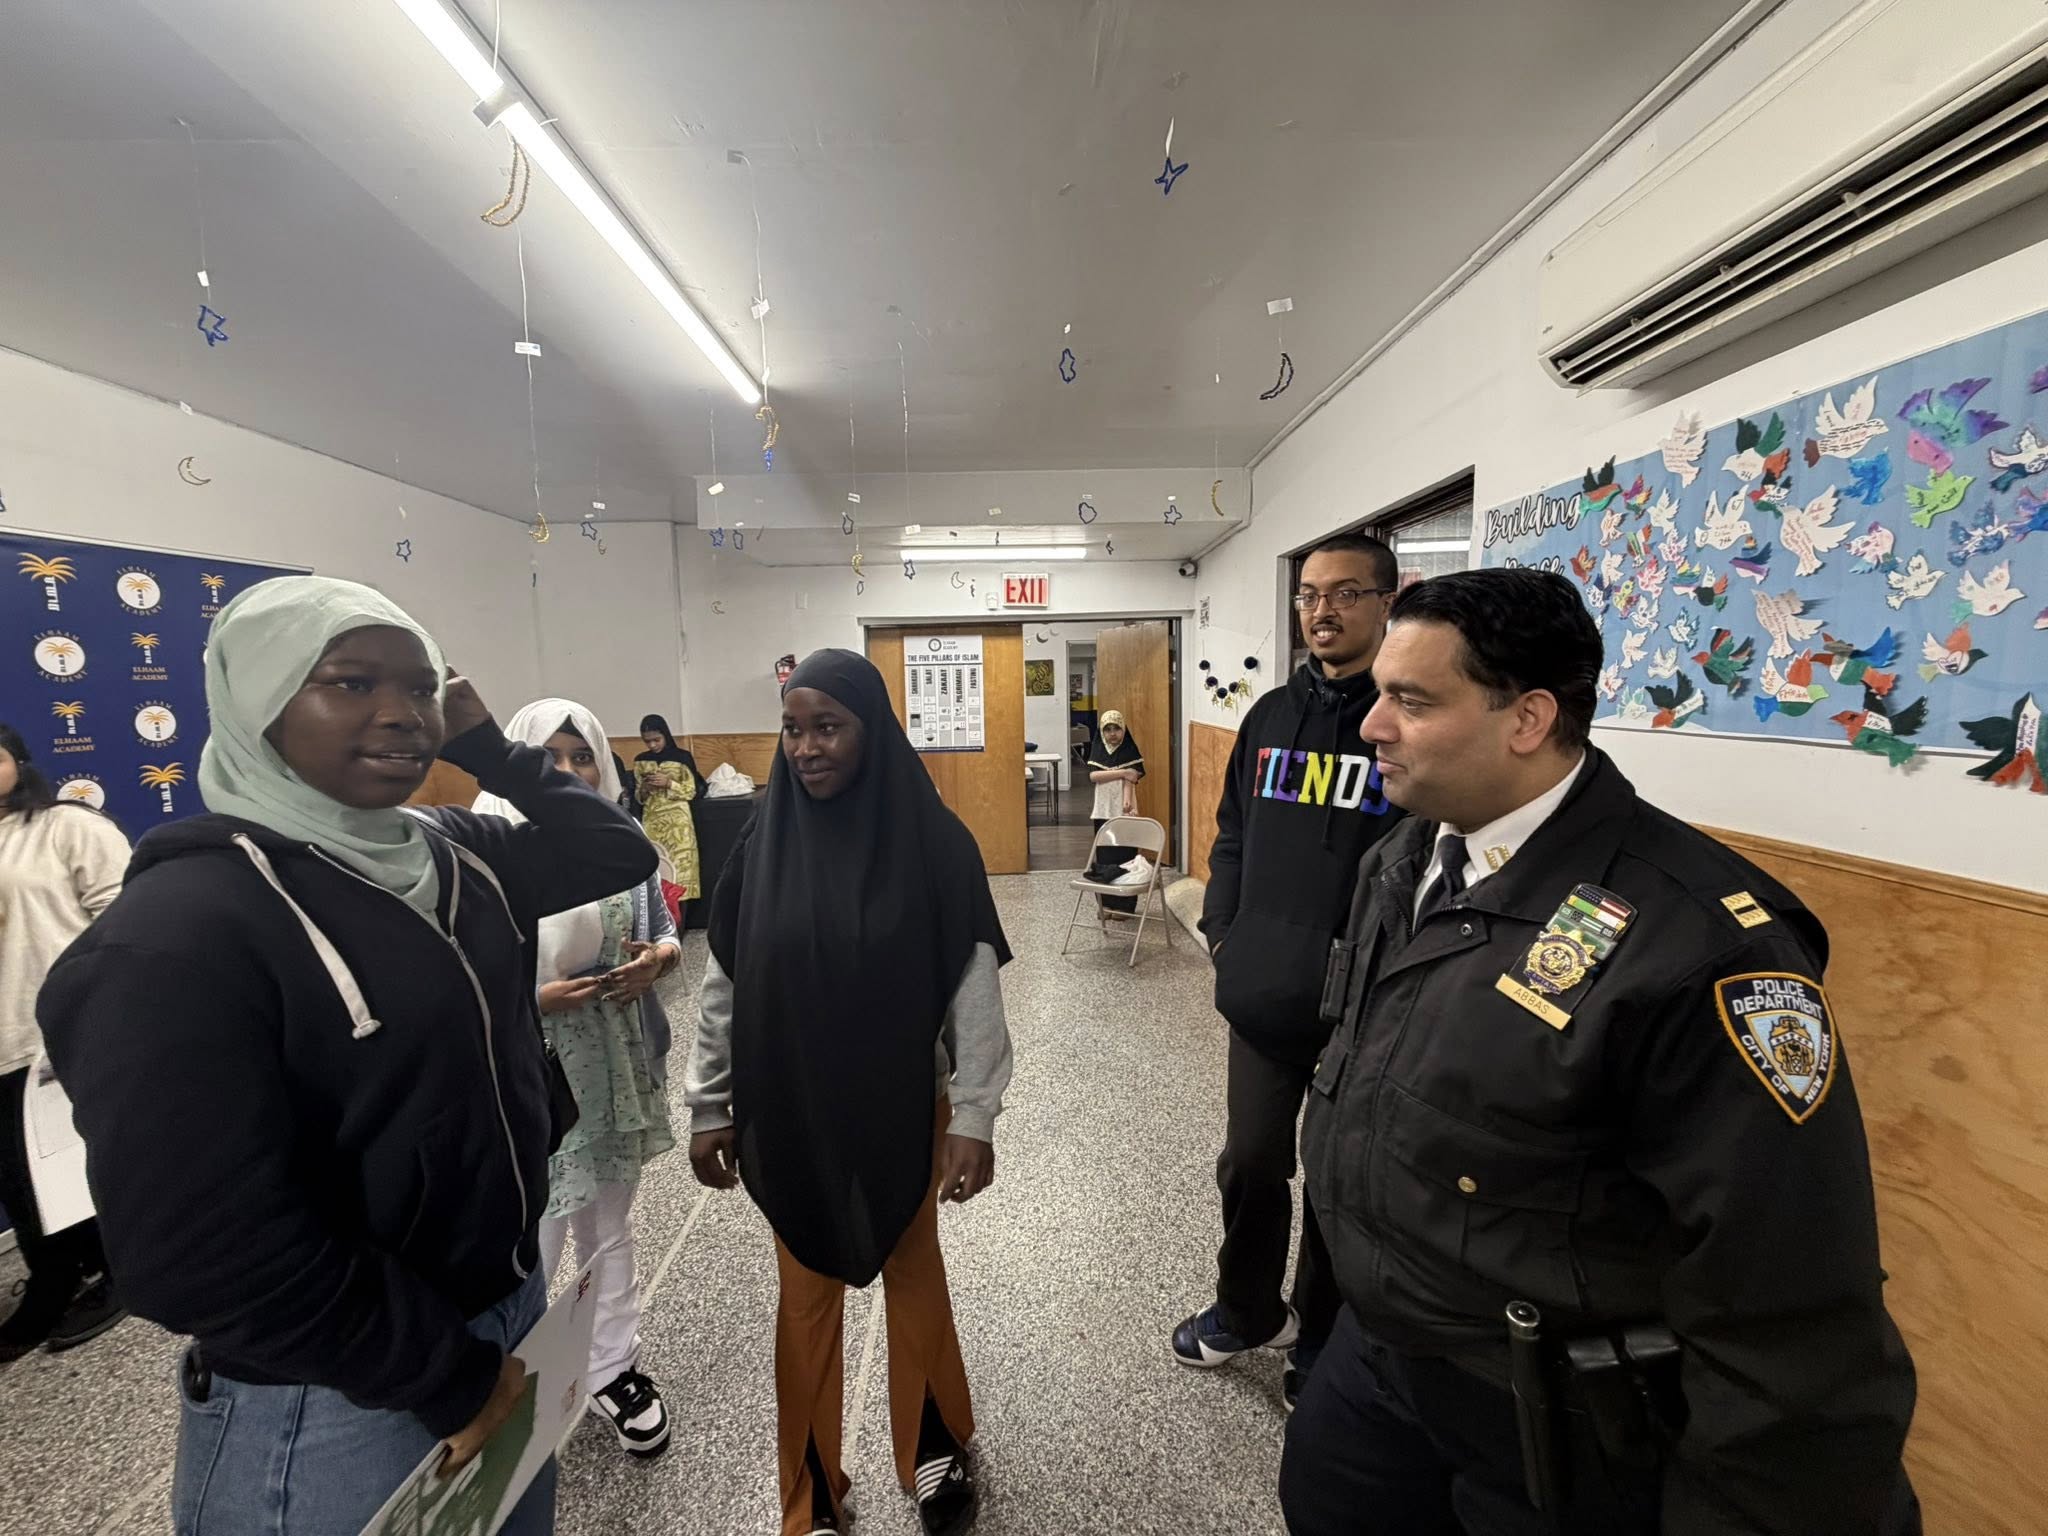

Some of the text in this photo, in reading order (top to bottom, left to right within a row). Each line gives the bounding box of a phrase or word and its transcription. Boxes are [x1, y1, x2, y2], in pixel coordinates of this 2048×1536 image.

[1483, 492, 1582, 548] Building
[1006, 578, 1043, 604] EXIT
[931, 654, 953, 662] PILLARS
[52, 745, 96, 753] ACADEMY
[53, 736, 92, 745] ELHAAM
[1513, 987, 1550, 1015] ABBAS
[1752, 980, 1806, 998] POLICE
[1732, 994, 1823, 1020] DEPARTMENT
[1741, 1034, 1791, 1095] CITY OF
[1804, 1033, 1830, 1104] NEW YORK
